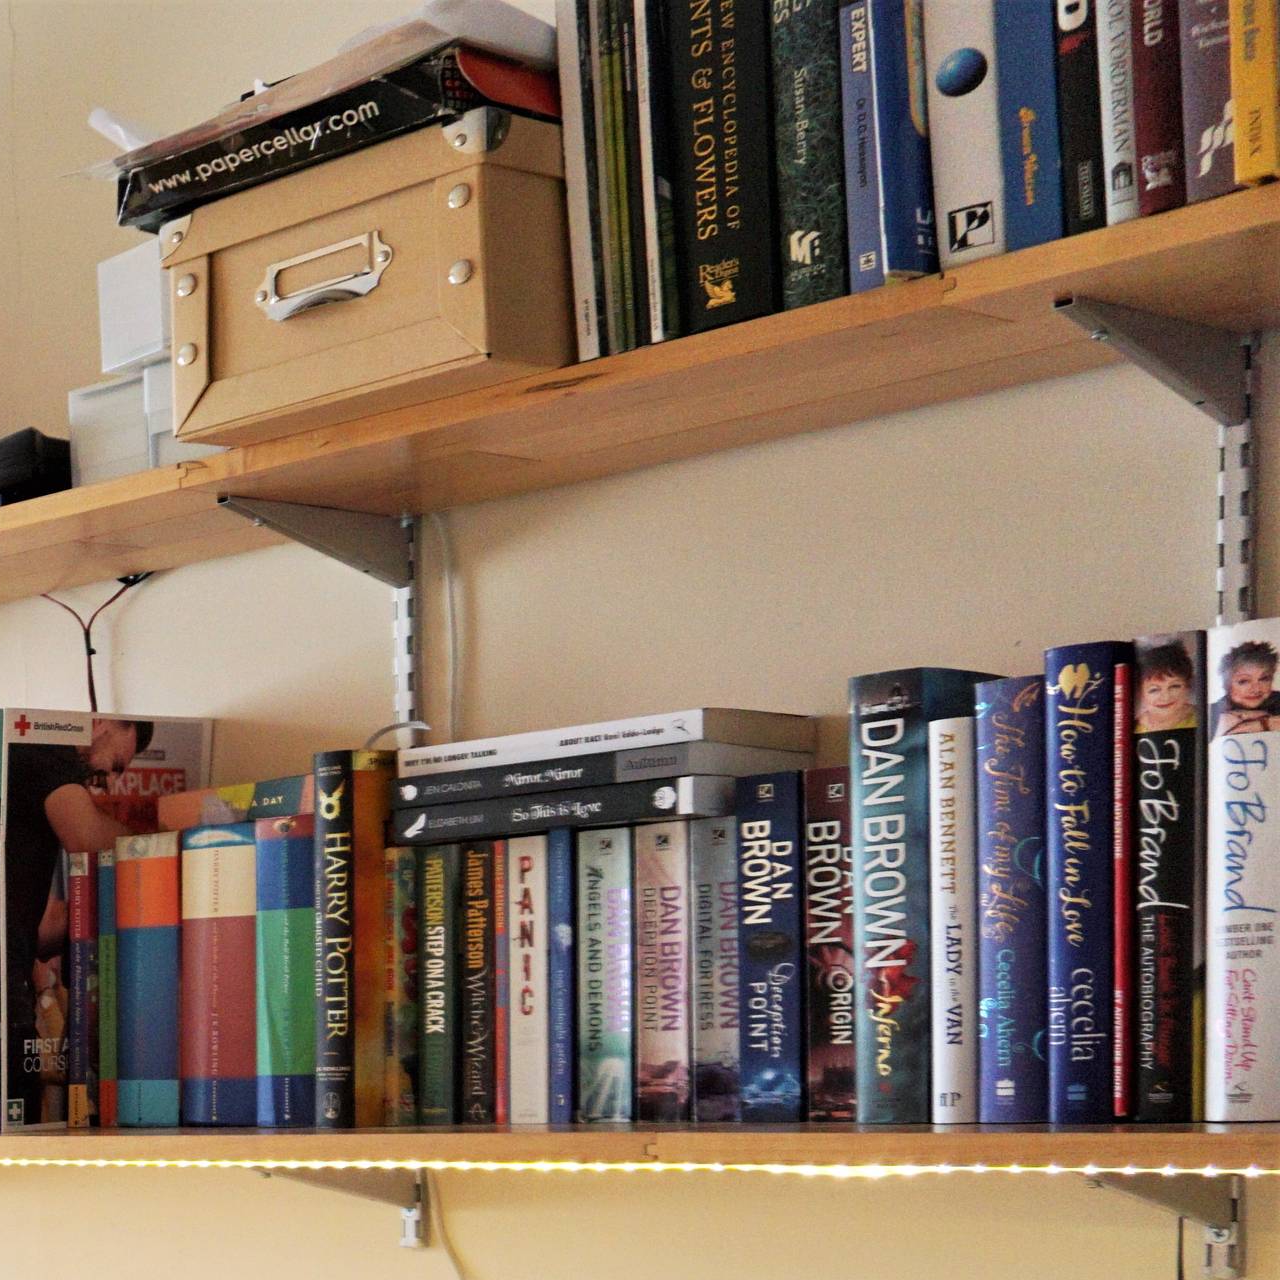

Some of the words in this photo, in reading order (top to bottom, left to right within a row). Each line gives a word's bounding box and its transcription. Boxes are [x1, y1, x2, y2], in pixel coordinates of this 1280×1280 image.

[849, 7, 868, 74] EXPERT
[690, 68, 713, 89] &
[792, 68, 808, 113] Susan
[1107, 31, 1134, 155] VORDERMAN
[721, 38, 740, 197] ENCYCLOPEDIA
[794, 118, 810, 166] Berry
[147, 100, 380, 195] www.papercellar.com
[692, 97, 719, 241] FLOWERS
[725, 204, 741, 230] OF
[469, 748, 498, 760] TALKING
[558, 736, 582, 747] ABOUT
[861, 717, 906, 807] DAN
[939, 732, 957, 790] ALAN
[992, 713, 1027, 756] The
[1056, 704, 1100, 764] How
[985, 758, 1030, 814] Time
[1059, 765, 1088, 795] to
[1139, 737, 1180, 790] Jo
[1224, 737, 1269, 791] Jo
[263, 795, 284, 807] DAY
[509, 806, 528, 824] So
[529, 804, 554, 822] This
[557, 804, 568, 820] is
[569, 799, 603, 819] Love
[1054, 800, 1092, 853] Fall
[939, 798, 957, 895] BENNETT
[1114, 801, 1125, 860] ADVENTURE
[1136, 790, 1191, 912] Brand
[1223, 791, 1278, 913] Brand
[324, 831, 352, 926] HARRY
[466, 850, 486, 897] James
[741, 819, 772, 925] BROWN
[771, 840, 795, 900] DAN
[807, 820, 844, 945] BROWN
[982, 844, 1011, 879] my
[1065, 857, 1085, 888] in
[425, 857, 444, 926] PATTERSON
[496, 885, 506, 929] PATTERSON
[587, 866, 603, 932] ANGELS
[606, 887, 630, 939] DAN
[659, 885, 683, 936] DAN
[696, 883, 713, 941] DIGITAL
[719, 880, 739, 931] DAN
[862, 813, 907, 969] BROWN
[1059, 888, 1092, 950] Love
[73, 908, 85, 940] POTTER
[315, 912, 323, 957] CURSED
[426, 925, 445, 957] STEP
[467, 899, 486, 969] Patterson
[516, 855, 535, 1016] PANIC
[642, 887, 658, 978] DECEPTION
[945, 924, 963, 976] LADY
[1141, 914, 1156, 943] THE
[315, 960, 324, 999] CHILD
[427, 958, 446, 980] ON
[588, 937, 603, 973] AND
[719, 936, 740, 1030] BROWN
[996, 948, 1016, 1011] Cecelia
[324, 936, 353, 1041] POTTER
[426, 990, 445, 1034] CRACK
[428, 980, 446, 989] A
[606, 942, 630, 1033] BROWN
[643, 984, 658, 1032] POINT
[660, 941, 683, 1033] BROWN
[697, 949, 714, 1031] FORTRESS
[765, 962, 797, 1058] Deception
[826, 970, 855, 1045] ORIGIN
[1141, 947, 1158, 1070] AUTOBIOGRAPHY
[587, 978, 604, 1053] DEMONS
[748, 982, 769, 1052] POINT
[867, 989, 906, 1077] Inferno
[945, 1003, 964, 1046] VAN
[996, 1015, 1017, 1067] Ahern
[1050, 985, 1072, 1046] ahern
[1070, 968, 1109, 1063] cecelia
[1114, 1006, 1125, 1064] ADVENTURE
[1241, 1006, 1257, 1049] Stand
[23, 1038, 61, 1055] FIRST
[1235, 1050, 1258, 1072] Up
